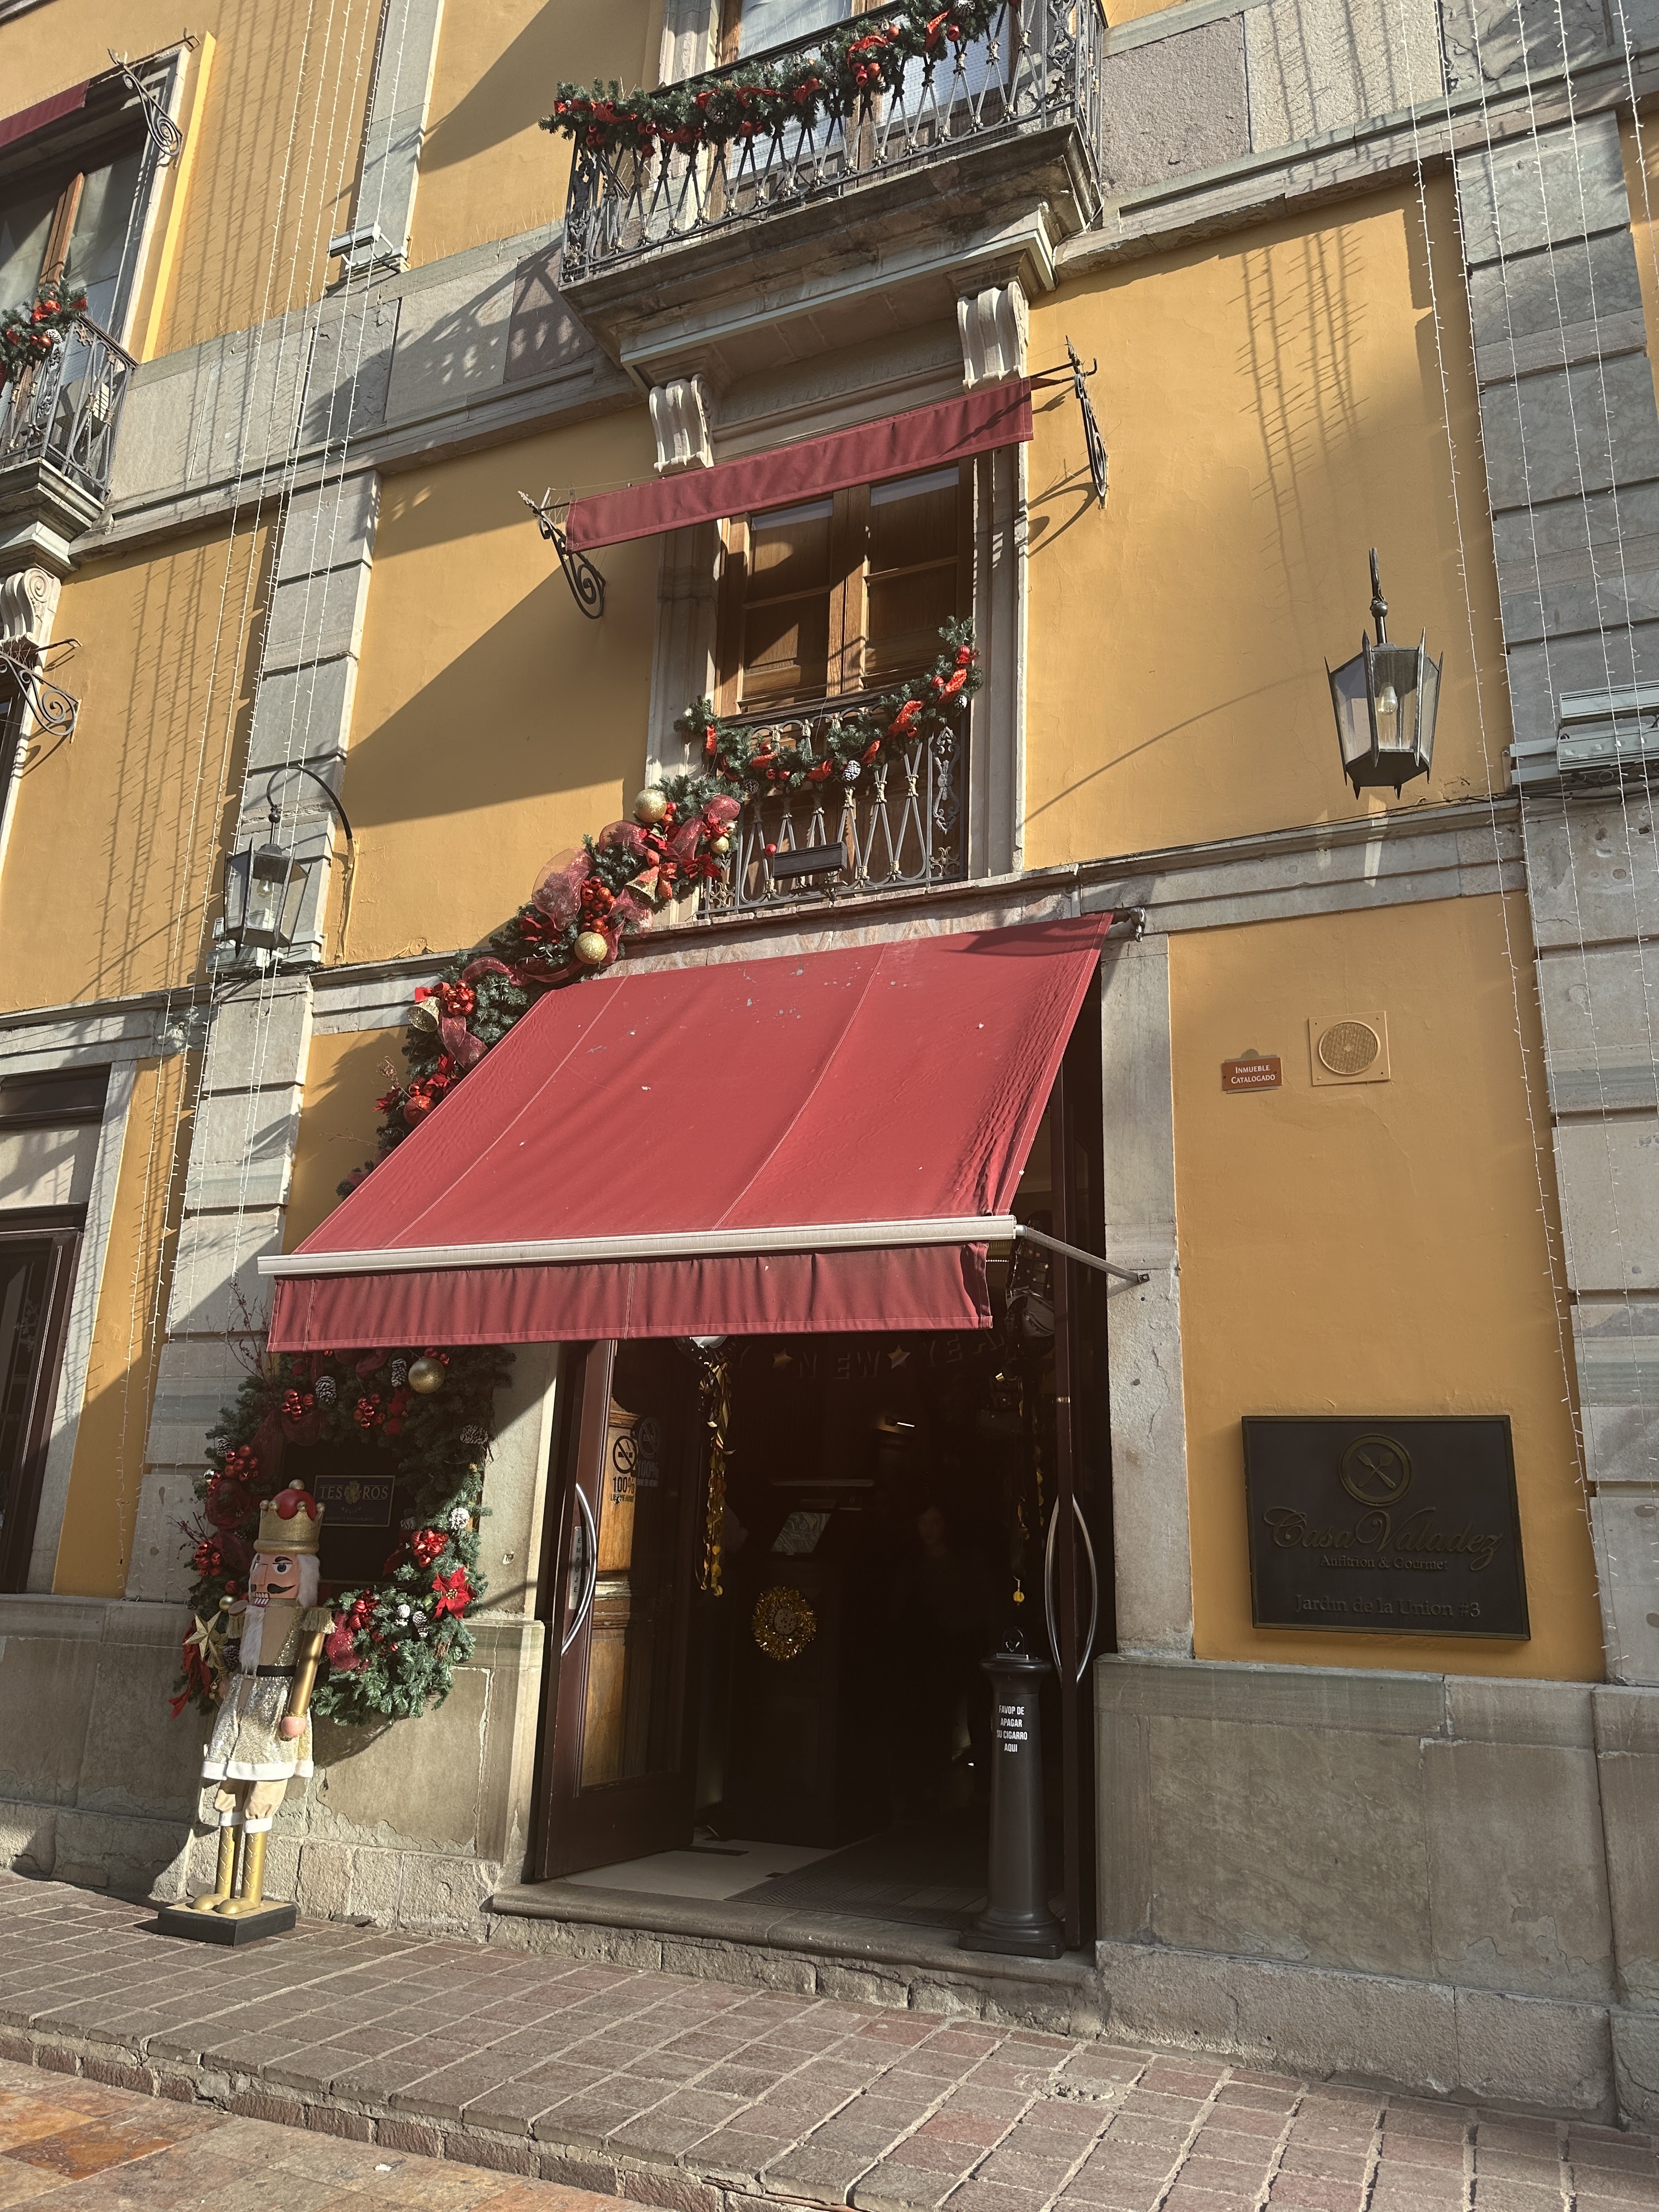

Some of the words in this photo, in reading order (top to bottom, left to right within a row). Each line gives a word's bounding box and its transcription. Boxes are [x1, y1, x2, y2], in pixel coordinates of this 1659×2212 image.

[1235, 1065, 1271, 1074] INMUEBLE
[1231, 1074, 1276, 1084] CATALOGADO
[1263, 1505, 1356, 1549] Casa
[1355, 1506, 1503, 1572] Valadez
[1320, 1554, 1375, 1567] Anfitrion
[1378, 1556, 1391, 1568] &
[1393, 1556, 1448, 1570] Gourmet
[1352, 1596, 1374, 1613] de
[1376, 1597, 1394, 1614] la
[1397, 1599, 1454, 1616] Union
[1458, 1601, 1481, 1618] #3
[1017, 1706, 1025, 1716] DE
[1000, 1717, 1023, 1728] APAGAR
[996, 1729, 1003, 1739] SU
[1003, 1730, 1028, 1740] CIGARRO
[1004, 1743, 1018, 1752] AQUI
